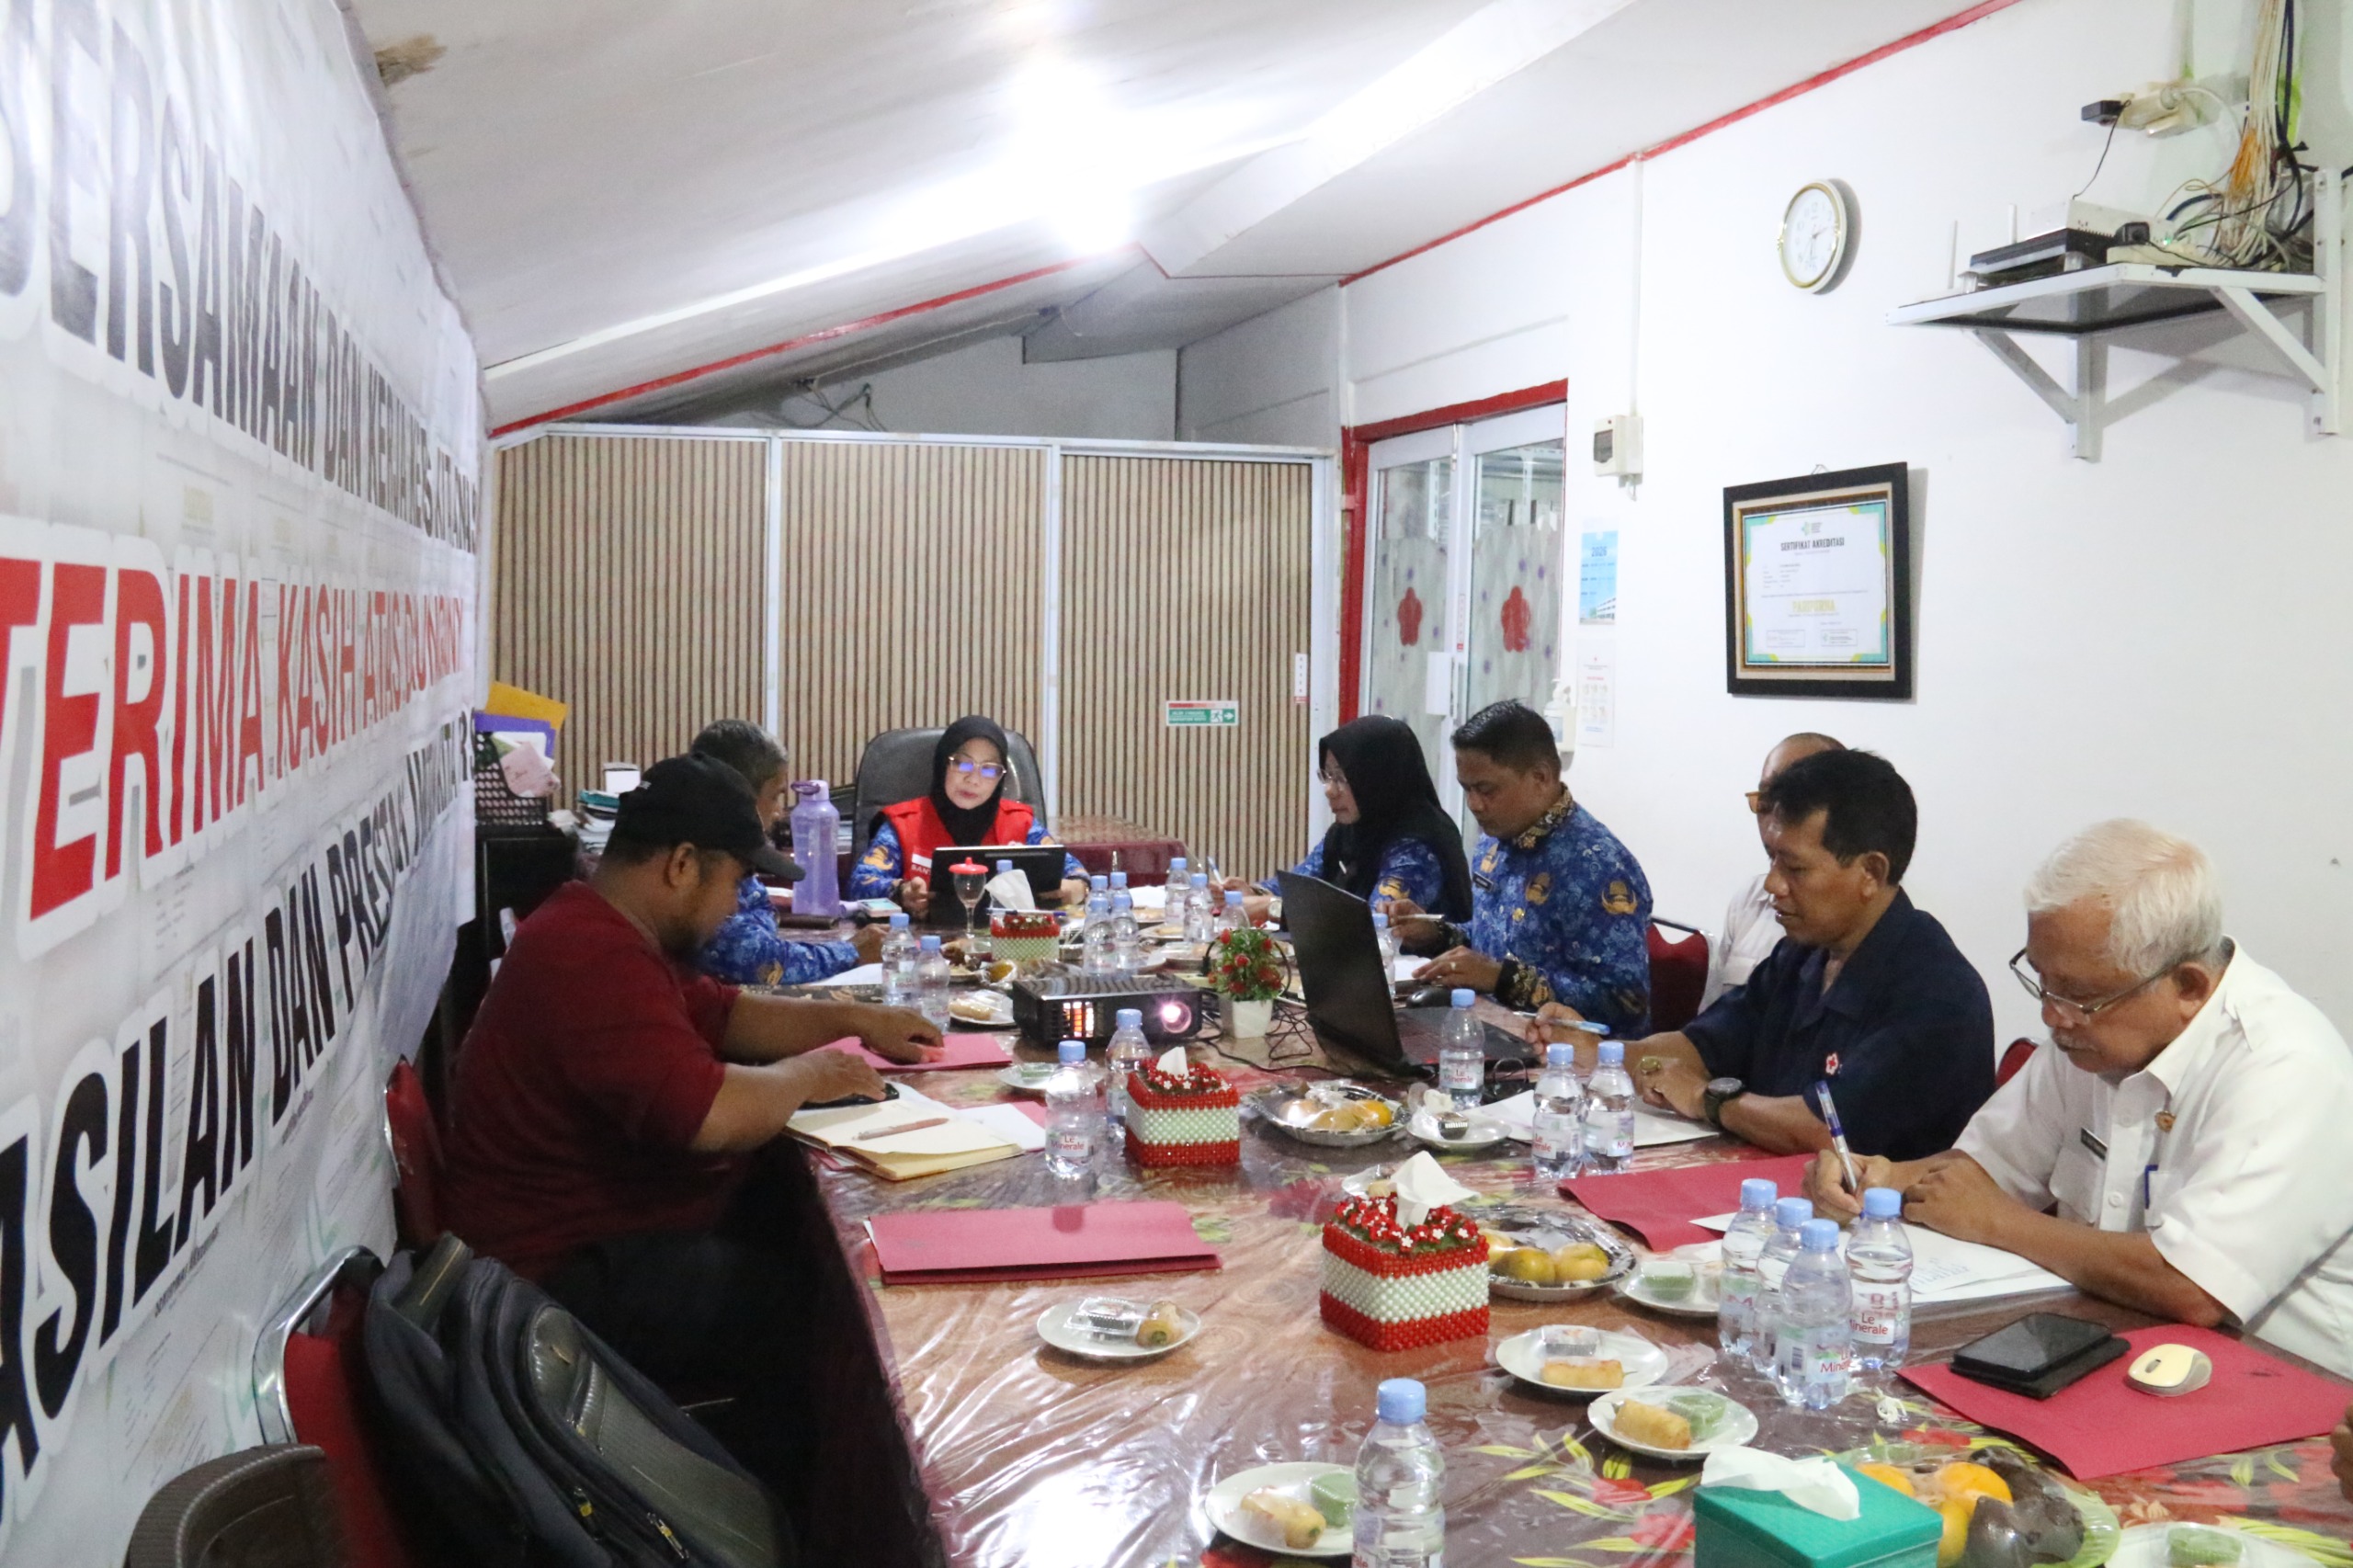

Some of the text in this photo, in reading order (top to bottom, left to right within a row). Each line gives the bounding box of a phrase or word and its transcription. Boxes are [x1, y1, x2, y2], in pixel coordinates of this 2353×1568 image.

[324, 309, 362, 499] DAN
[1780, 537, 1845, 551] SERTIFIKAT AKREDITASI
[276, 583, 357, 779] KASIH
[363, 590, 401, 729] ATAS
[265, 861, 335, 1128] DAN
[1861, 1312, 1875, 1325] Le
